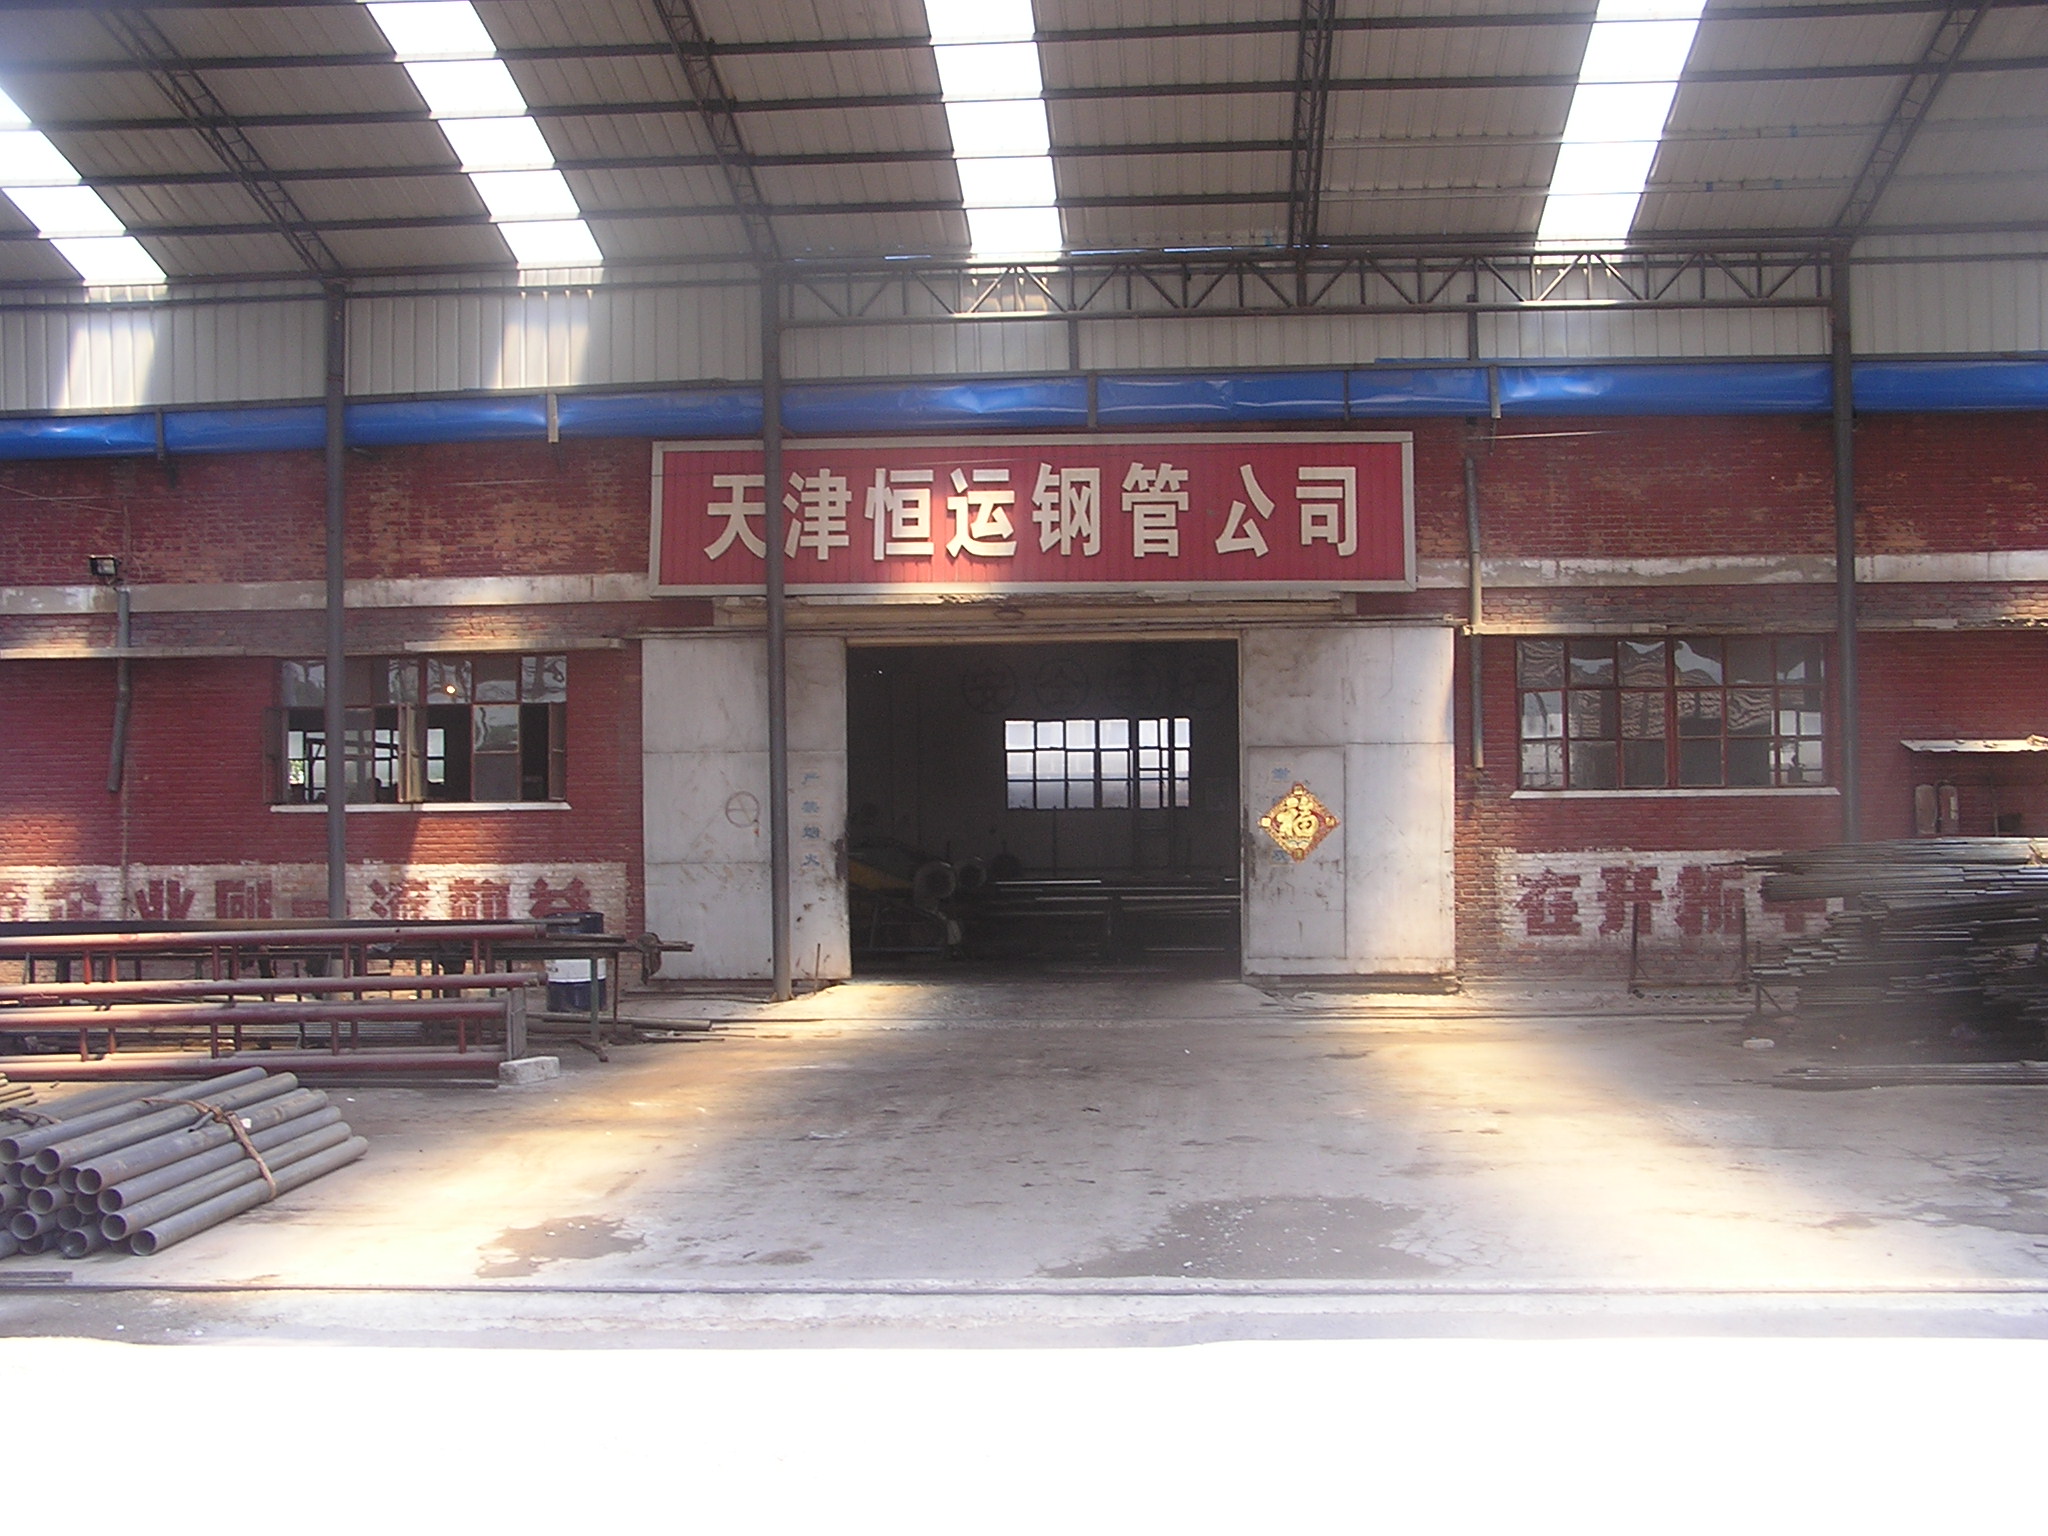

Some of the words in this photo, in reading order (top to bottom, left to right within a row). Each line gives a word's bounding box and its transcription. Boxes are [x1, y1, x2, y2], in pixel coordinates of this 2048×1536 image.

[704, 462, 1358, 562] 天津恒运钢管公司
